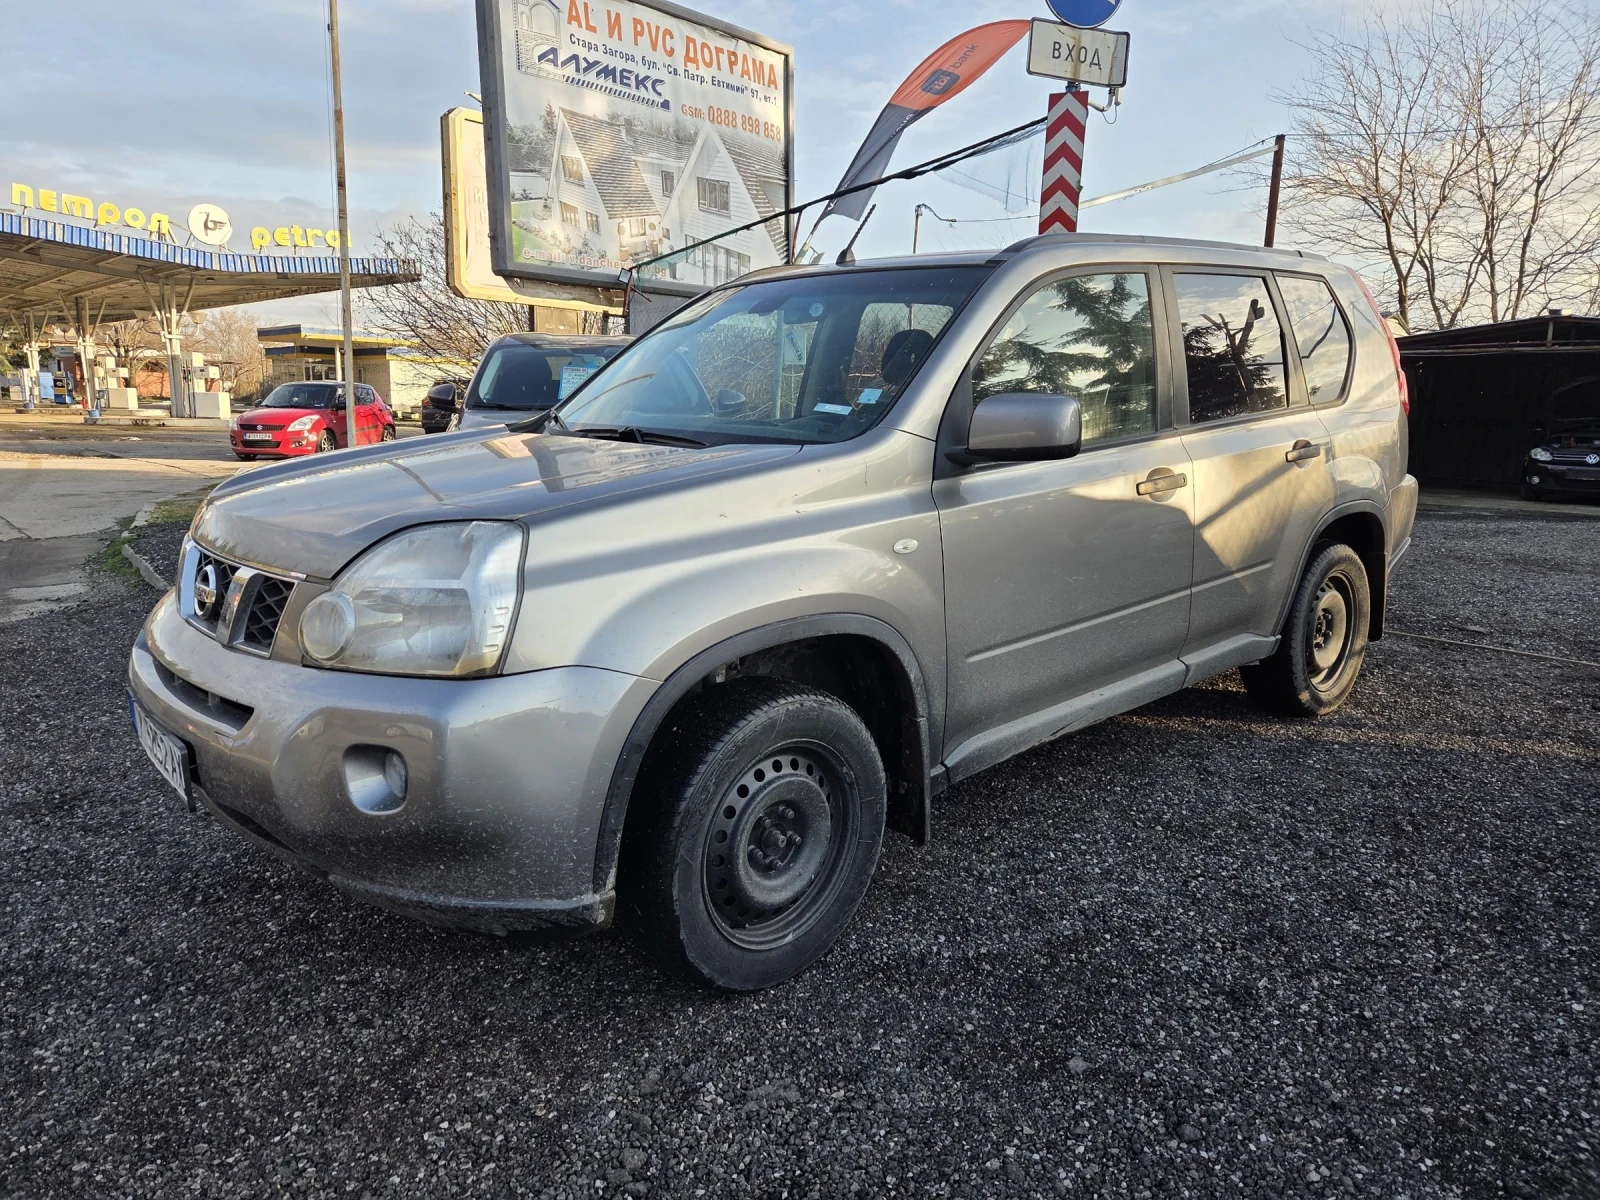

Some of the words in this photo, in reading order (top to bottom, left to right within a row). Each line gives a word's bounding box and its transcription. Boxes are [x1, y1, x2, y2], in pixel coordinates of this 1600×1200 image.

[566, 0, 597, 33] AL
[606, 9, 623, 41] И
[632, 17, 675, 58] PVC
[684, 35, 778, 90] ДОГРАМА
[949, 44, 979, 69] bank
[1052, 41, 1102, 71] ВХОД
[537, 46, 666, 97] АЛУМЕКС
[569, 33, 599, 52] Стара
[602, 43, 639, 66] Загора,
[641, 55, 660, 71] бул.
[683, 69, 708, 85] Патр.
[750, 88, 762, 102] 97,
[932, 74, 951, 91] tbi
[681, 103, 705, 120] GSM:
[707, 105, 738, 129] 0888
[741, 113, 761, 136] 898
[763, 121, 781, 144] 858
[522, 247, 566, 263] e-mail:
[569, 253, 668, 277] v.danchev@bv.bg
